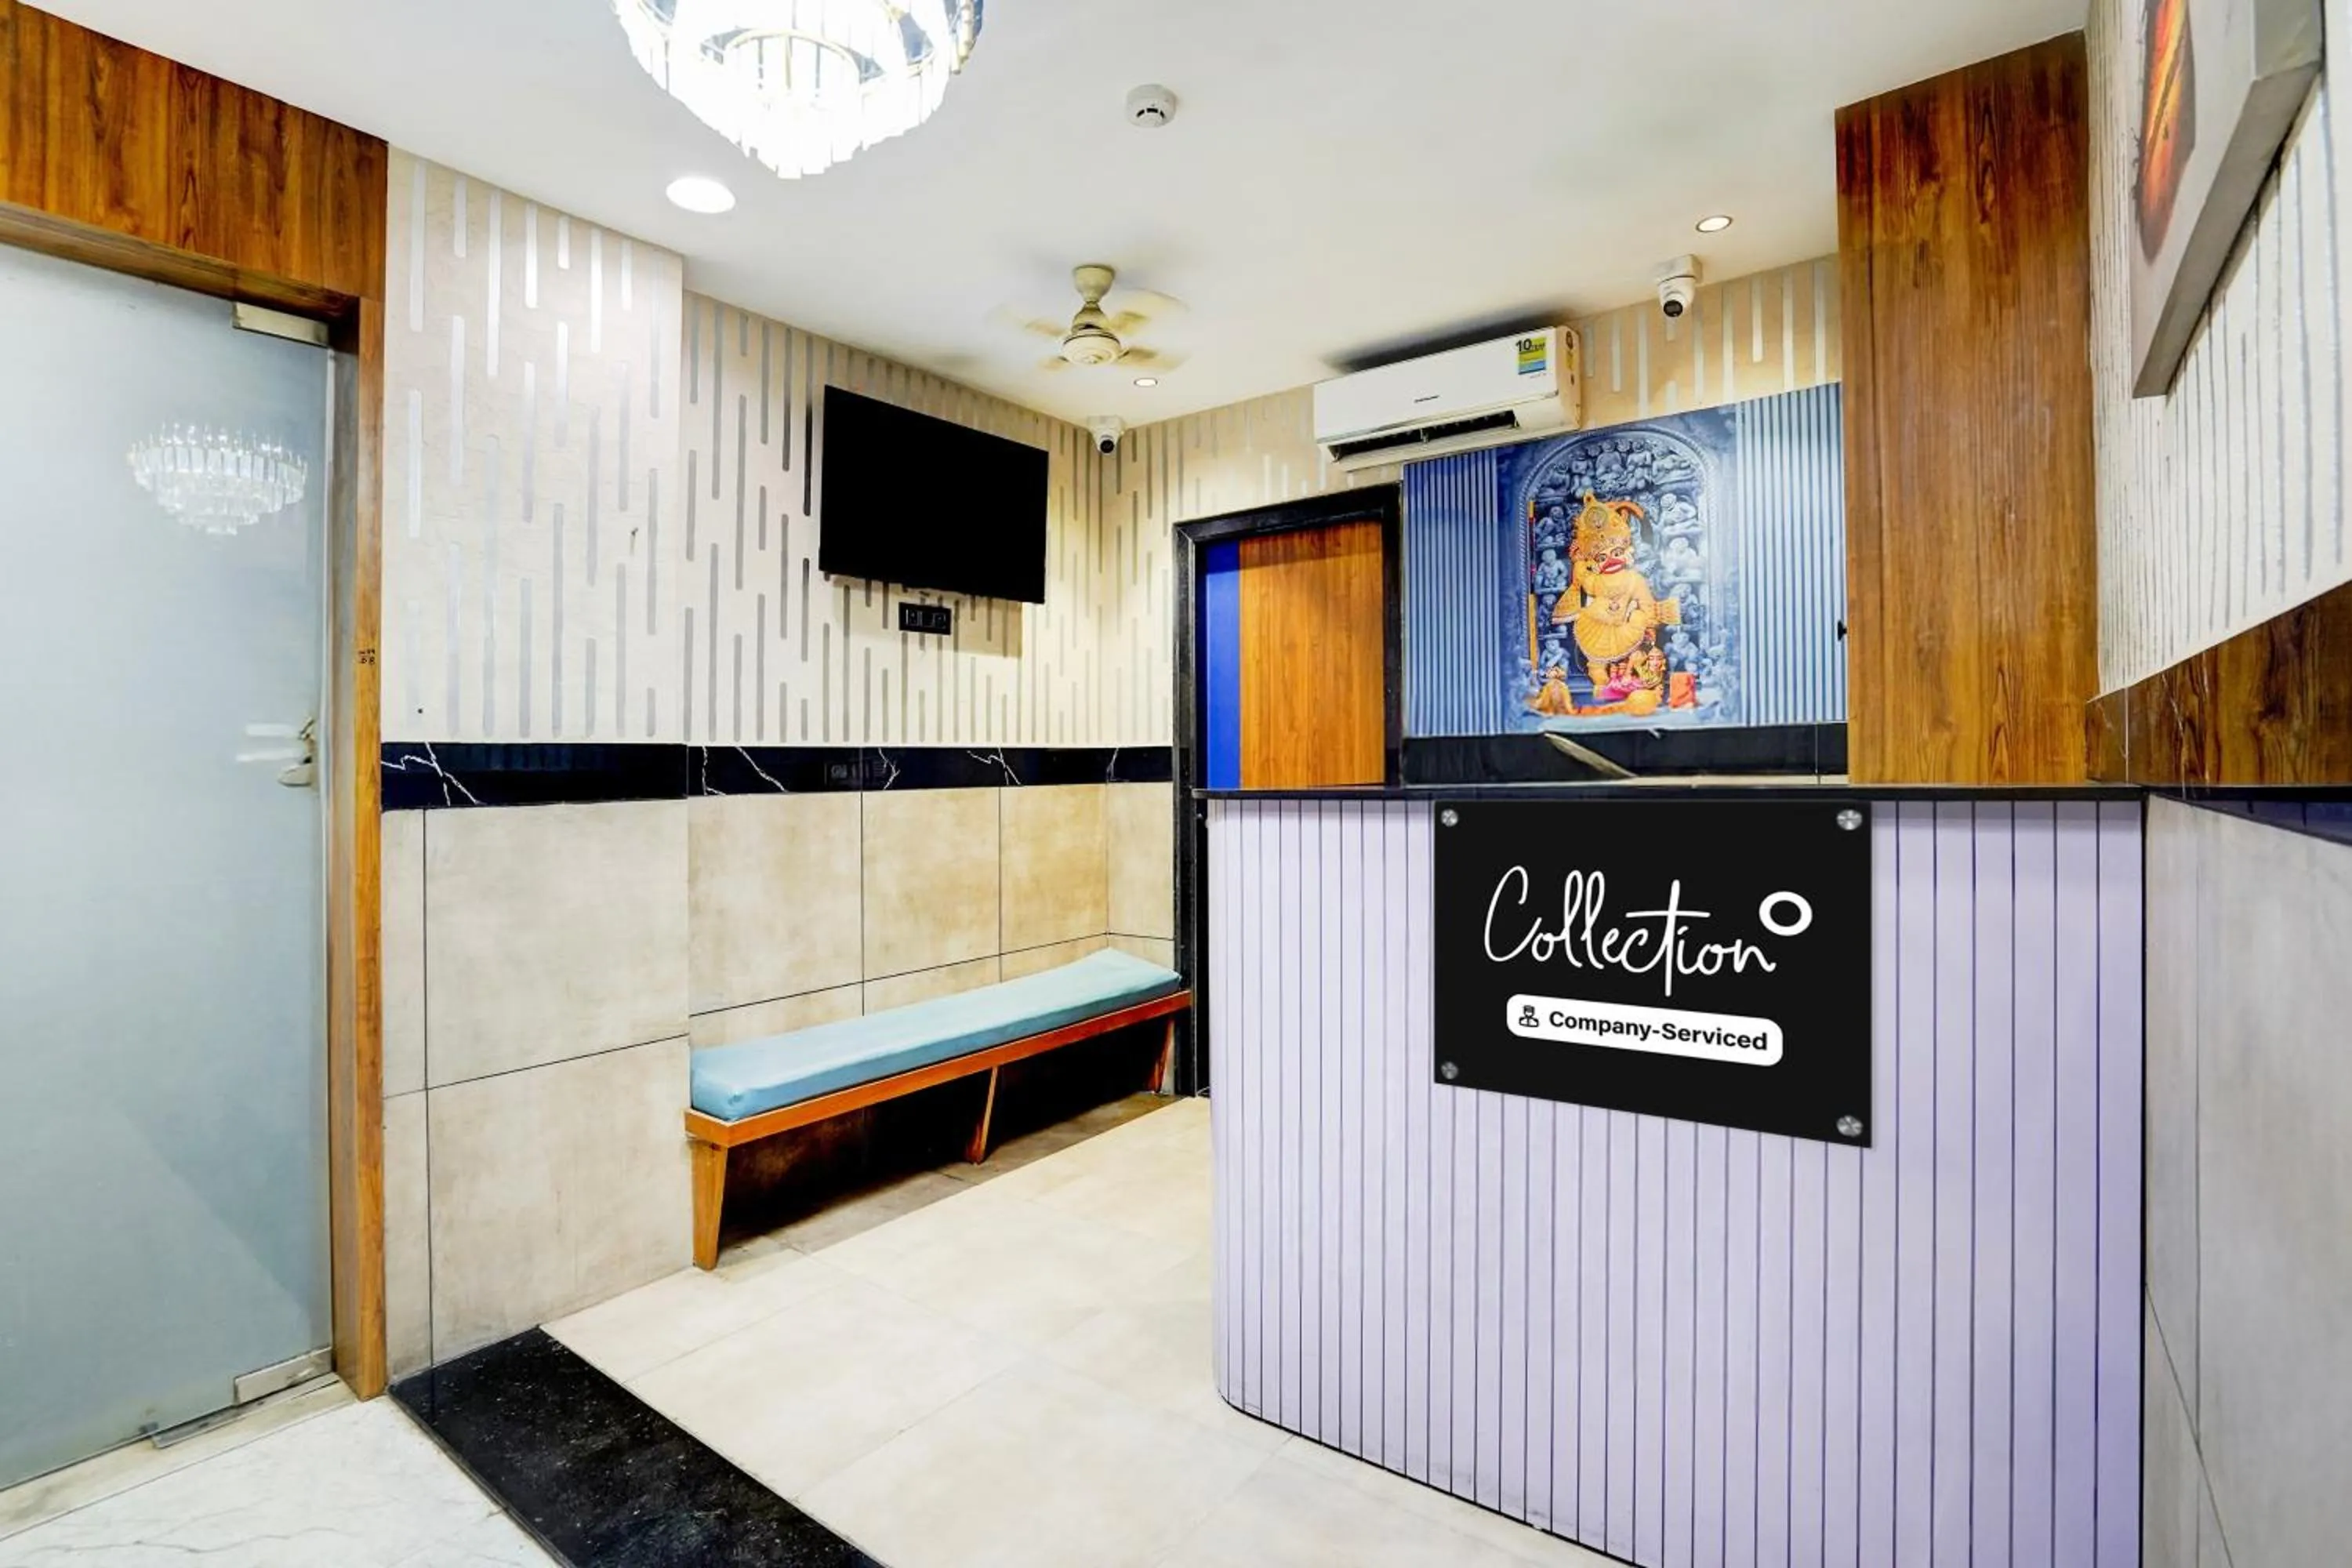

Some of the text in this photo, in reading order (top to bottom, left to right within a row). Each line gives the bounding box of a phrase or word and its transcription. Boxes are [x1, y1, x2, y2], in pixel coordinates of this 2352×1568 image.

[1516, 338, 1532, 352] 10
[1484, 866, 1777, 996] Collection
[1549, 1011, 1767, 1051] Company-Serviced
